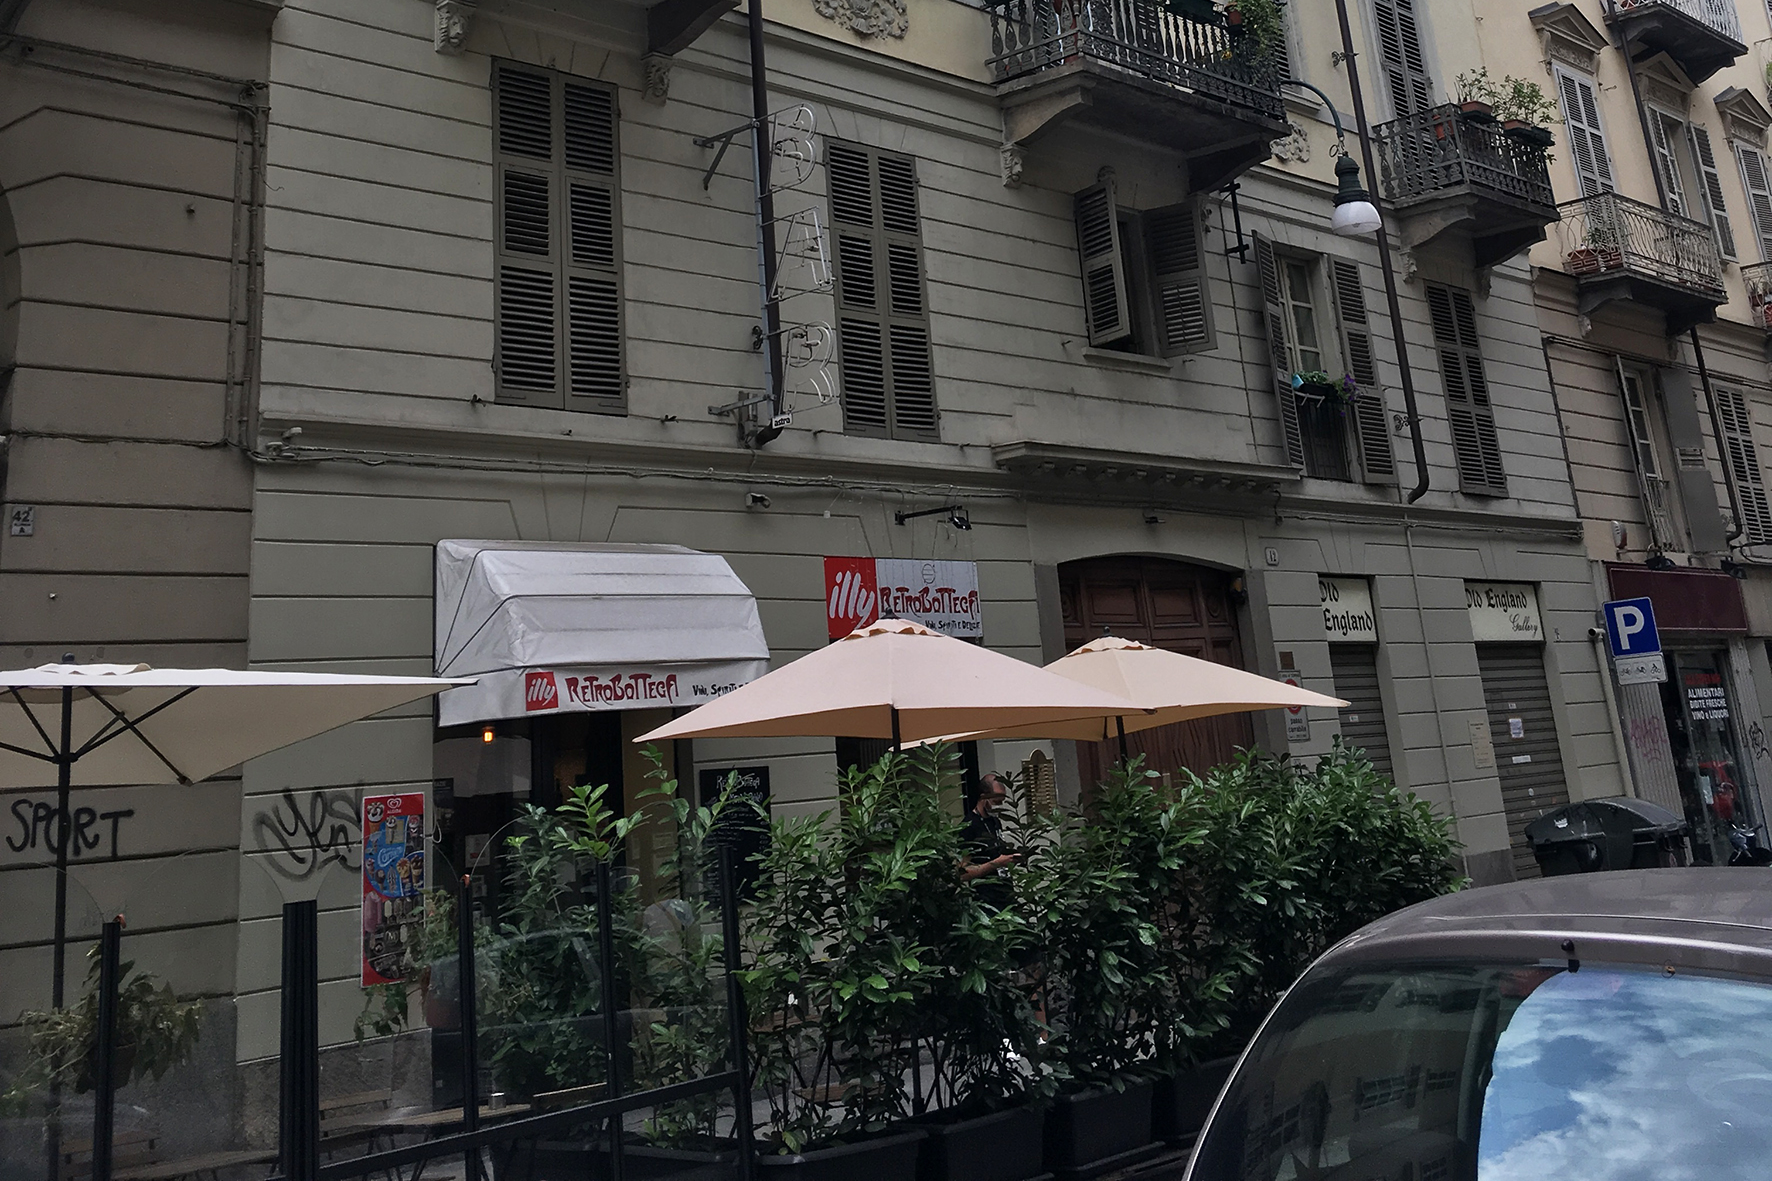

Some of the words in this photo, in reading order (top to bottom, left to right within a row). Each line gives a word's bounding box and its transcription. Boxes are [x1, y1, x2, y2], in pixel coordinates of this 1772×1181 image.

[13, 510, 30, 522] 42
[1269, 549, 1277, 563] 12
[829, 570, 875, 630] illy
[1318, 580, 1340, 602] Old
[1465, 588, 1483, 608] Old
[1485, 588, 1527, 613] England
[1323, 608, 1374, 636] England
[1509, 613, 1538, 638] Gallery
[1614, 605, 1645, 650] P
[527, 677, 555, 707] illy
[1688, 687, 1725, 699] ALIMENTARI
[1689, 700, 1706, 709] BIBITE
[1706, 698, 1727, 708] FRESCHE
[1691, 710, 1704, 720] VINO
[1709, 708, 1729, 719] LIQUORI
[6, 799, 135, 859] SPORT
